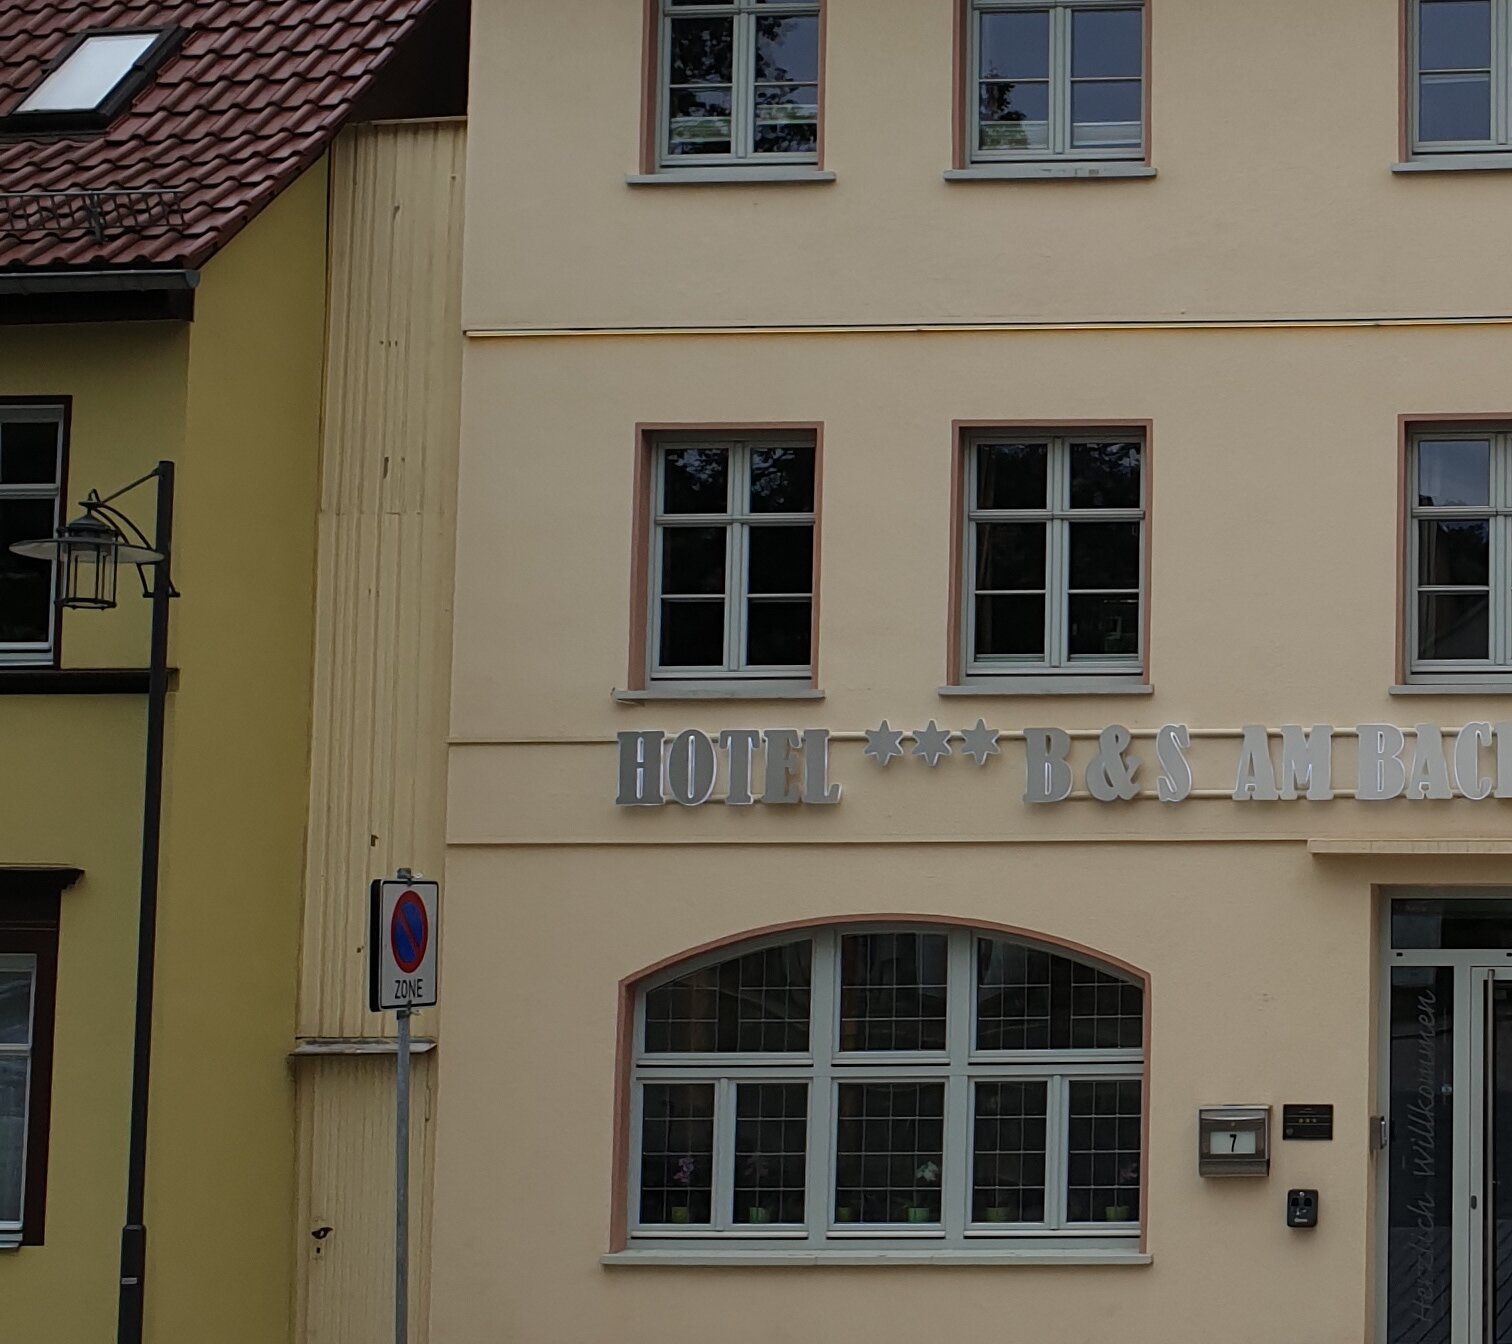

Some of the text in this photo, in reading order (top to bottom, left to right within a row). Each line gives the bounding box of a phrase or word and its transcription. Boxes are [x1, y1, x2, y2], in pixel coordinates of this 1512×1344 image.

[615, 728, 843, 808] HOTEL
[1232, 724, 1336, 803] AM
[394, 978, 424, 1000] ZONE
[1229, 1133, 1237, 1153] 7
[1405, 1193, 1437, 1323] Herzlich
